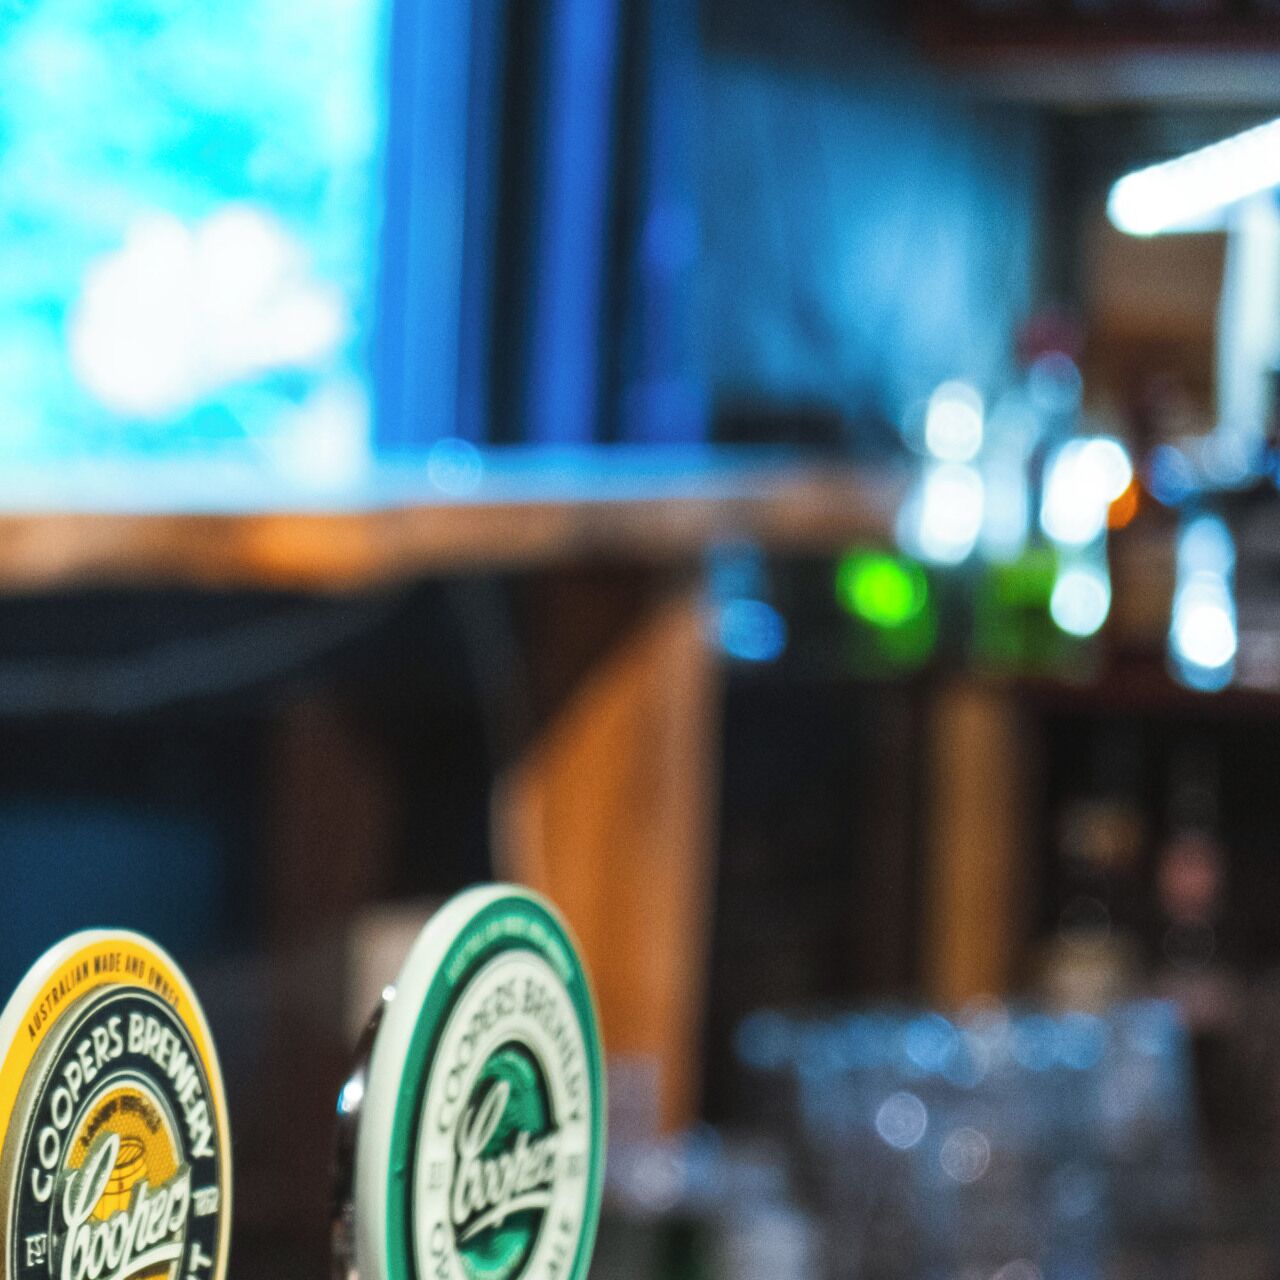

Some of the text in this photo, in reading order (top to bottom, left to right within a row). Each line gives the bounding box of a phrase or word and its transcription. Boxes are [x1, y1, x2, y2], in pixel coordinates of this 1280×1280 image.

[27, 960, 89, 1042] AUSTRALIAN
[94, 952, 122, 975] MADE
[125, 954, 145, 979] AND
[31, 1012, 215, 1203] COOPERS BREWERY
